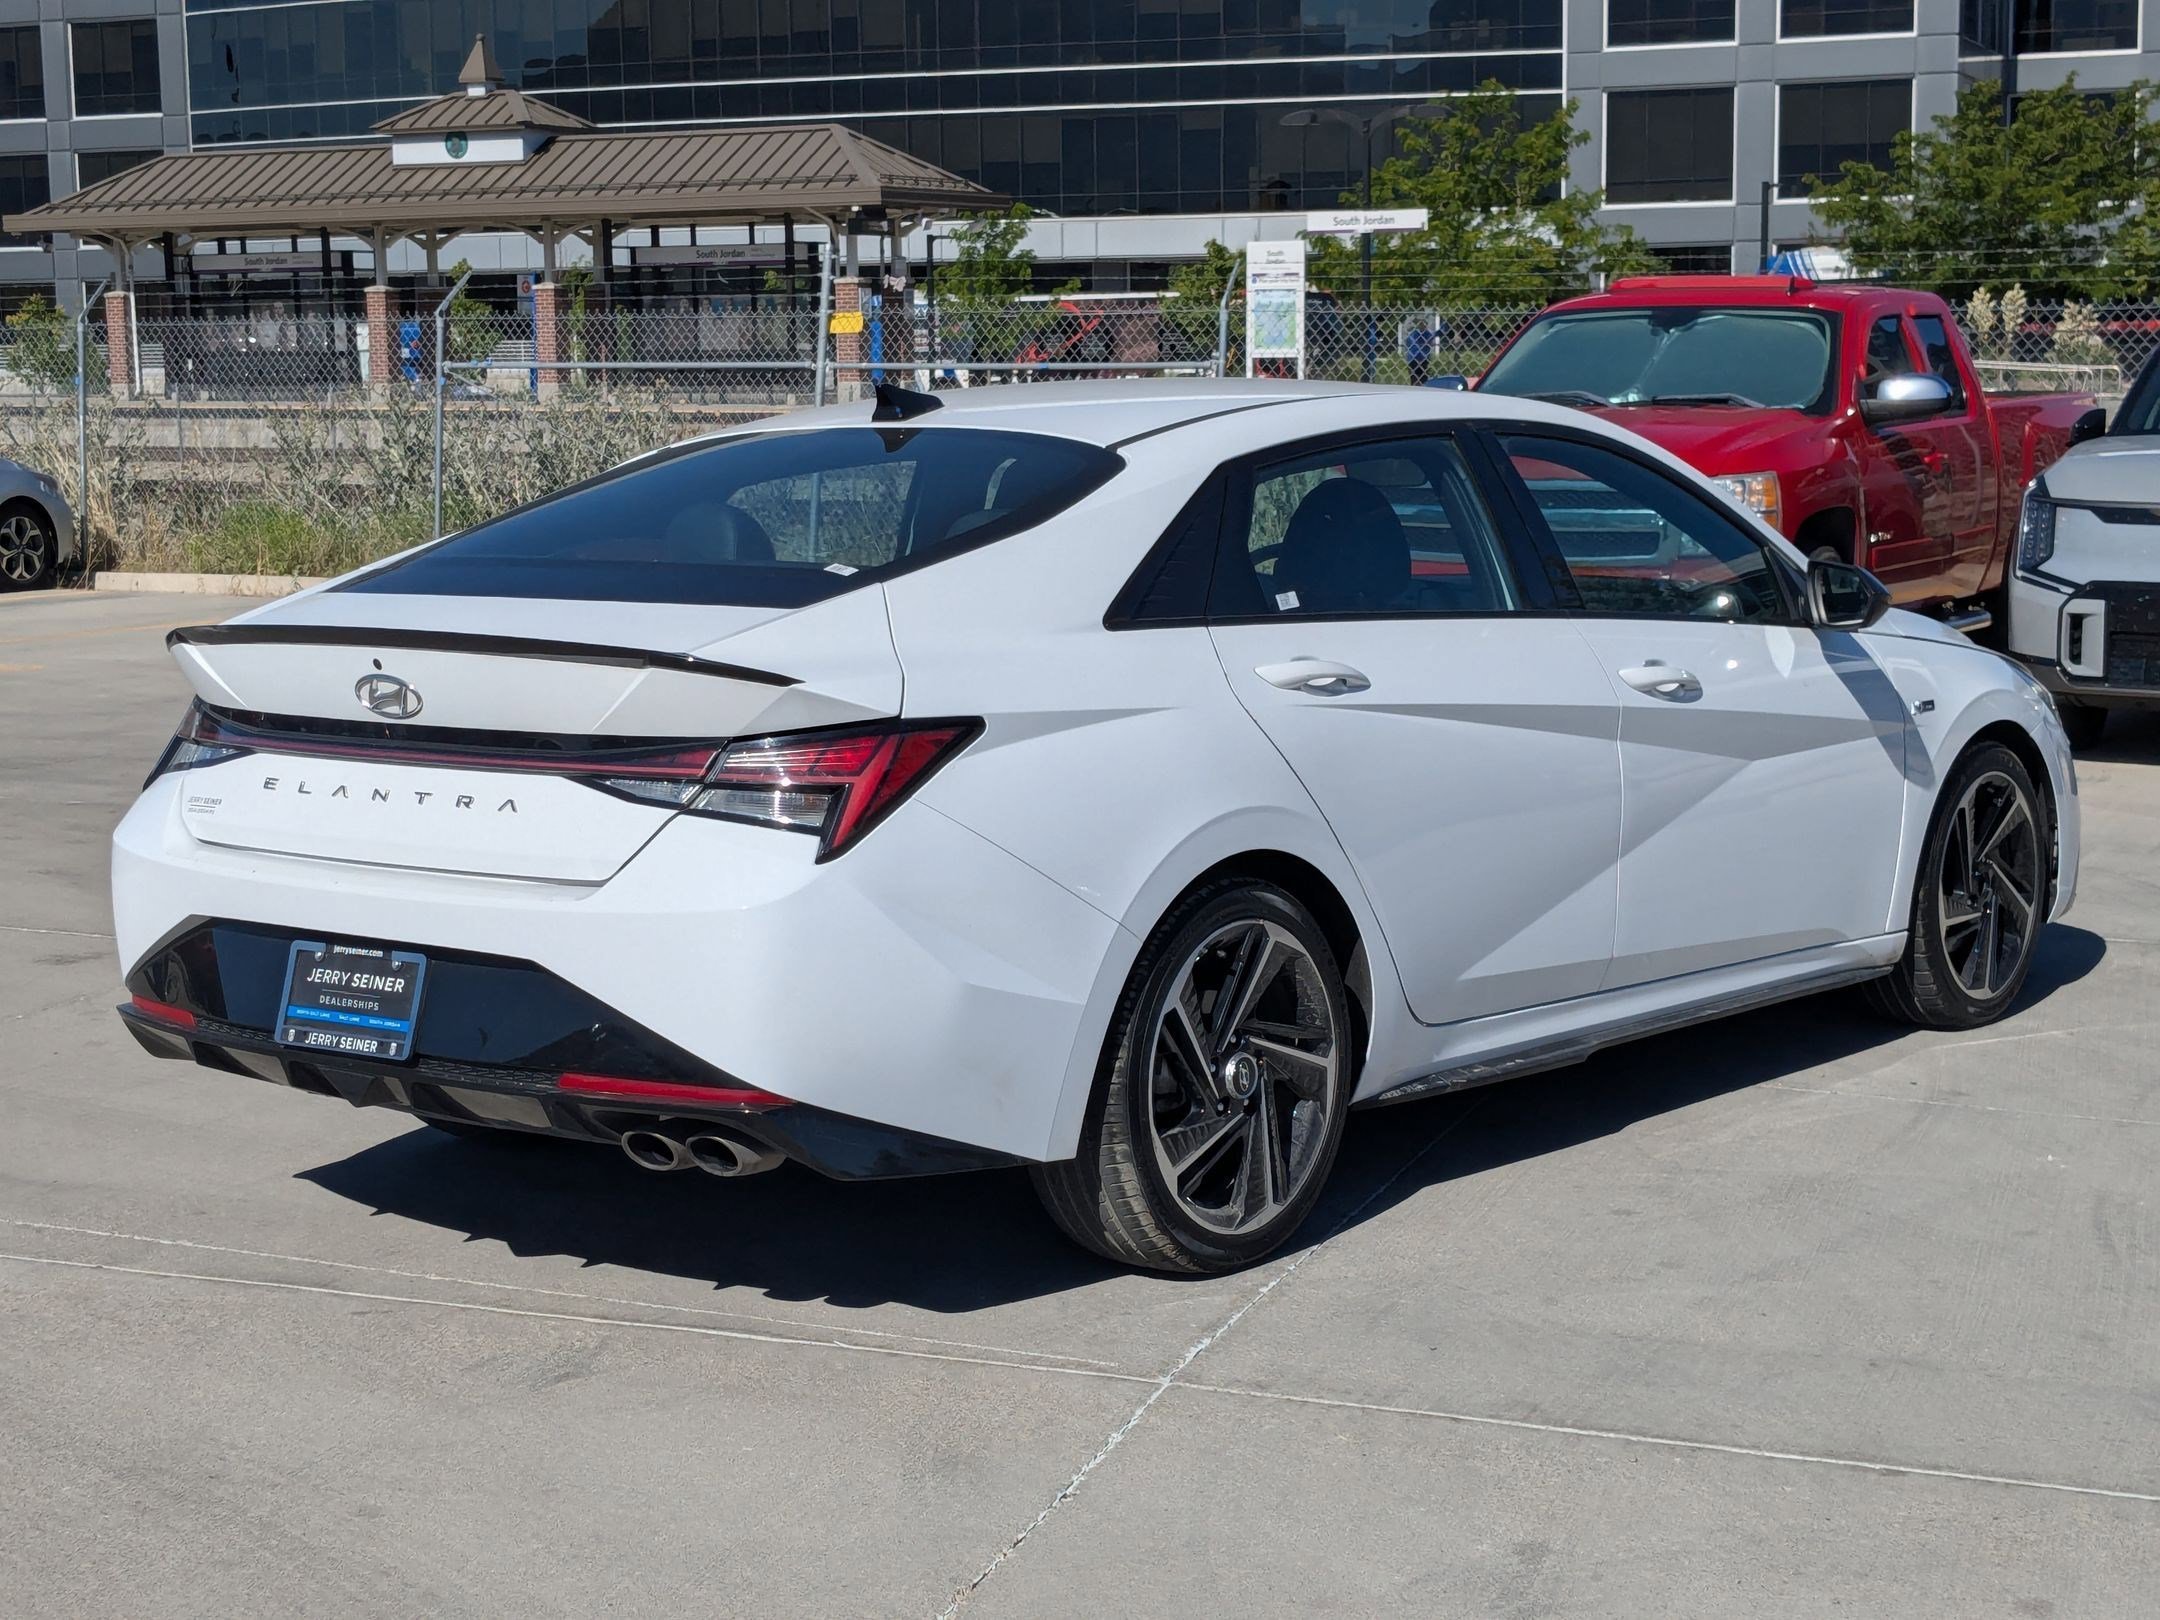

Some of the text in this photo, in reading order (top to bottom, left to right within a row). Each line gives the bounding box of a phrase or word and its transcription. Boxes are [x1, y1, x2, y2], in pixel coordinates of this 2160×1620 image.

[1333, 215, 1395, 226] South Jordan
[244, 257, 264, 266] South
[265, 255, 287, 265] Jordan
[696, 249, 718, 258] South
[720, 249, 745, 258] Jordan
[263, 776, 518, 813] ELANTRA
[333, 944, 384, 957] jerryseiner.com
[307, 968, 405, 993] JERRY SEINER
[319, 995, 379, 1011] DEALERSHIPS
[305, 1032, 378, 1053] JERRY SEINER
